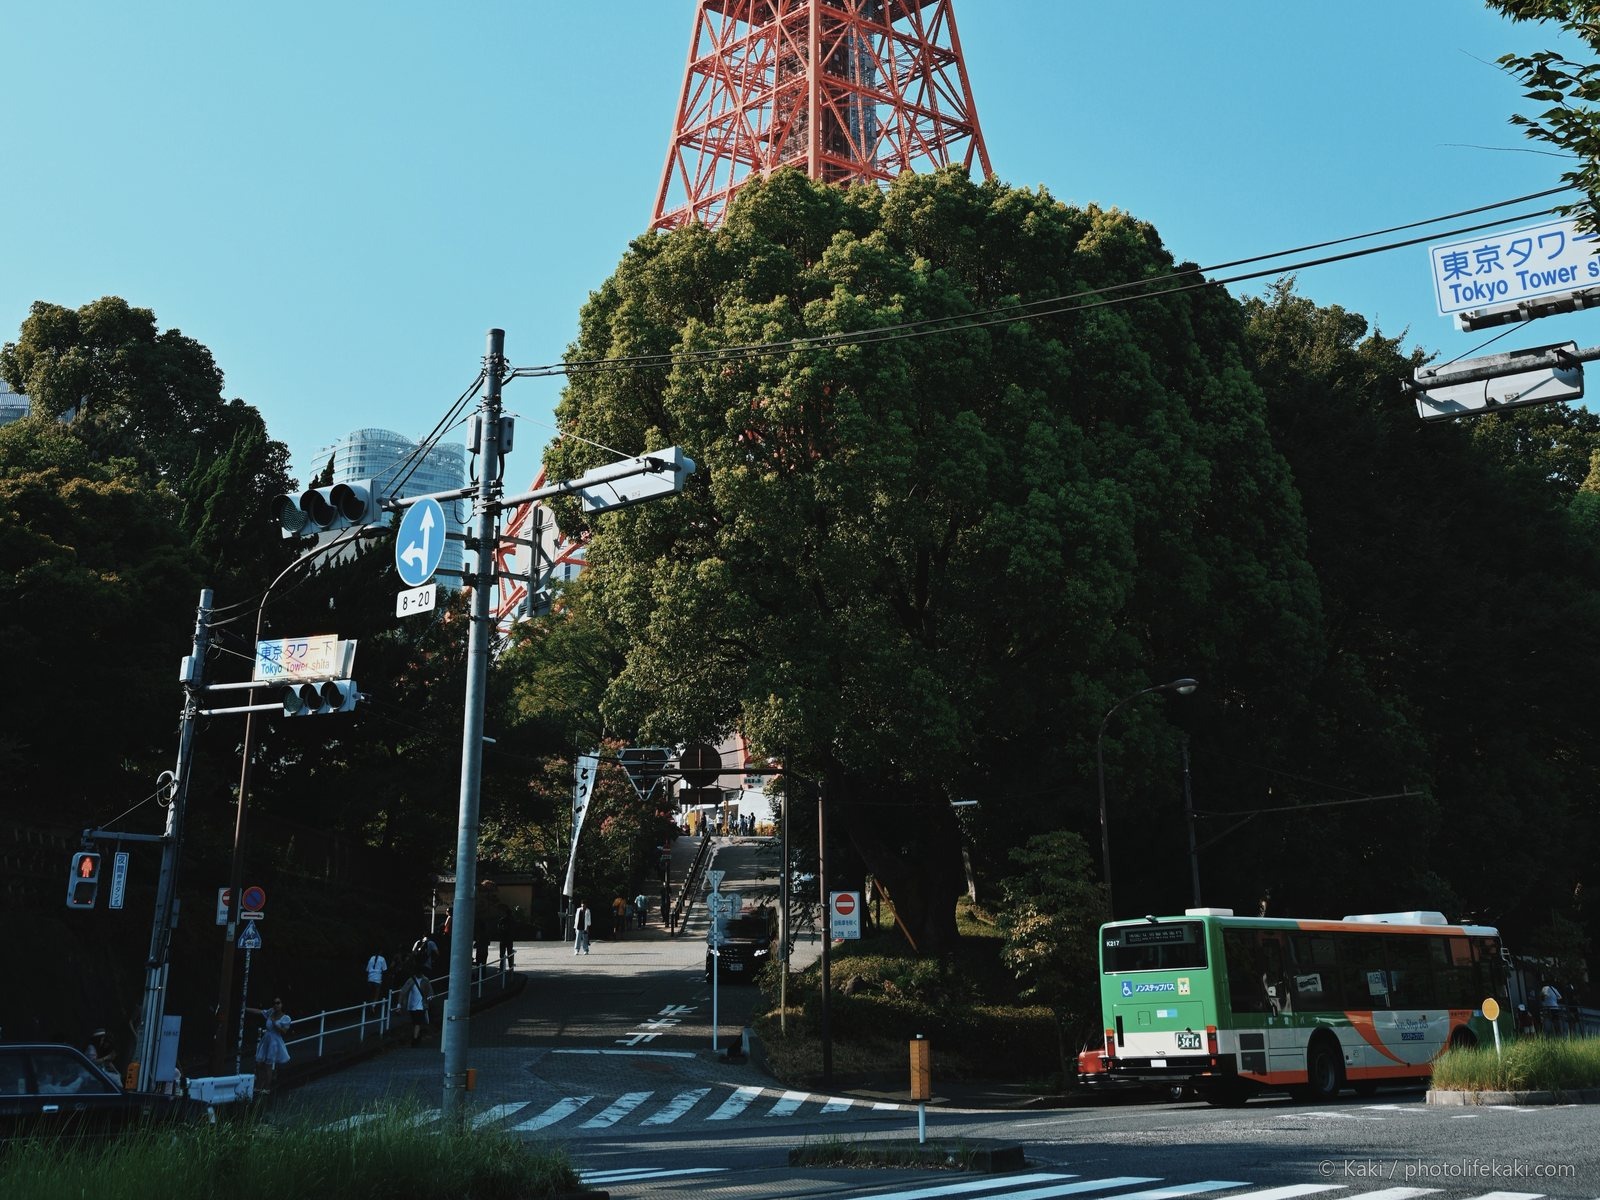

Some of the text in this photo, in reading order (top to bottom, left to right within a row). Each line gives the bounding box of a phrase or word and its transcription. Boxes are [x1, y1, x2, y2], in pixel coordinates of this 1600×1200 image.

[1440, 230, 1599, 282] 東京タワー
[1448, 279, 1509, 304] Tokyo
[1515, 263, 1578, 291] Tower
[402, 590, 430, 611] 8-20
[260, 640, 333, 662] 東京タワー下
[261, 657, 330, 675] Tokyo Tower shita
[1136, 983, 1175, 992] ノンステップバス
[1181, 1037, 1200, 1048] 34-16
